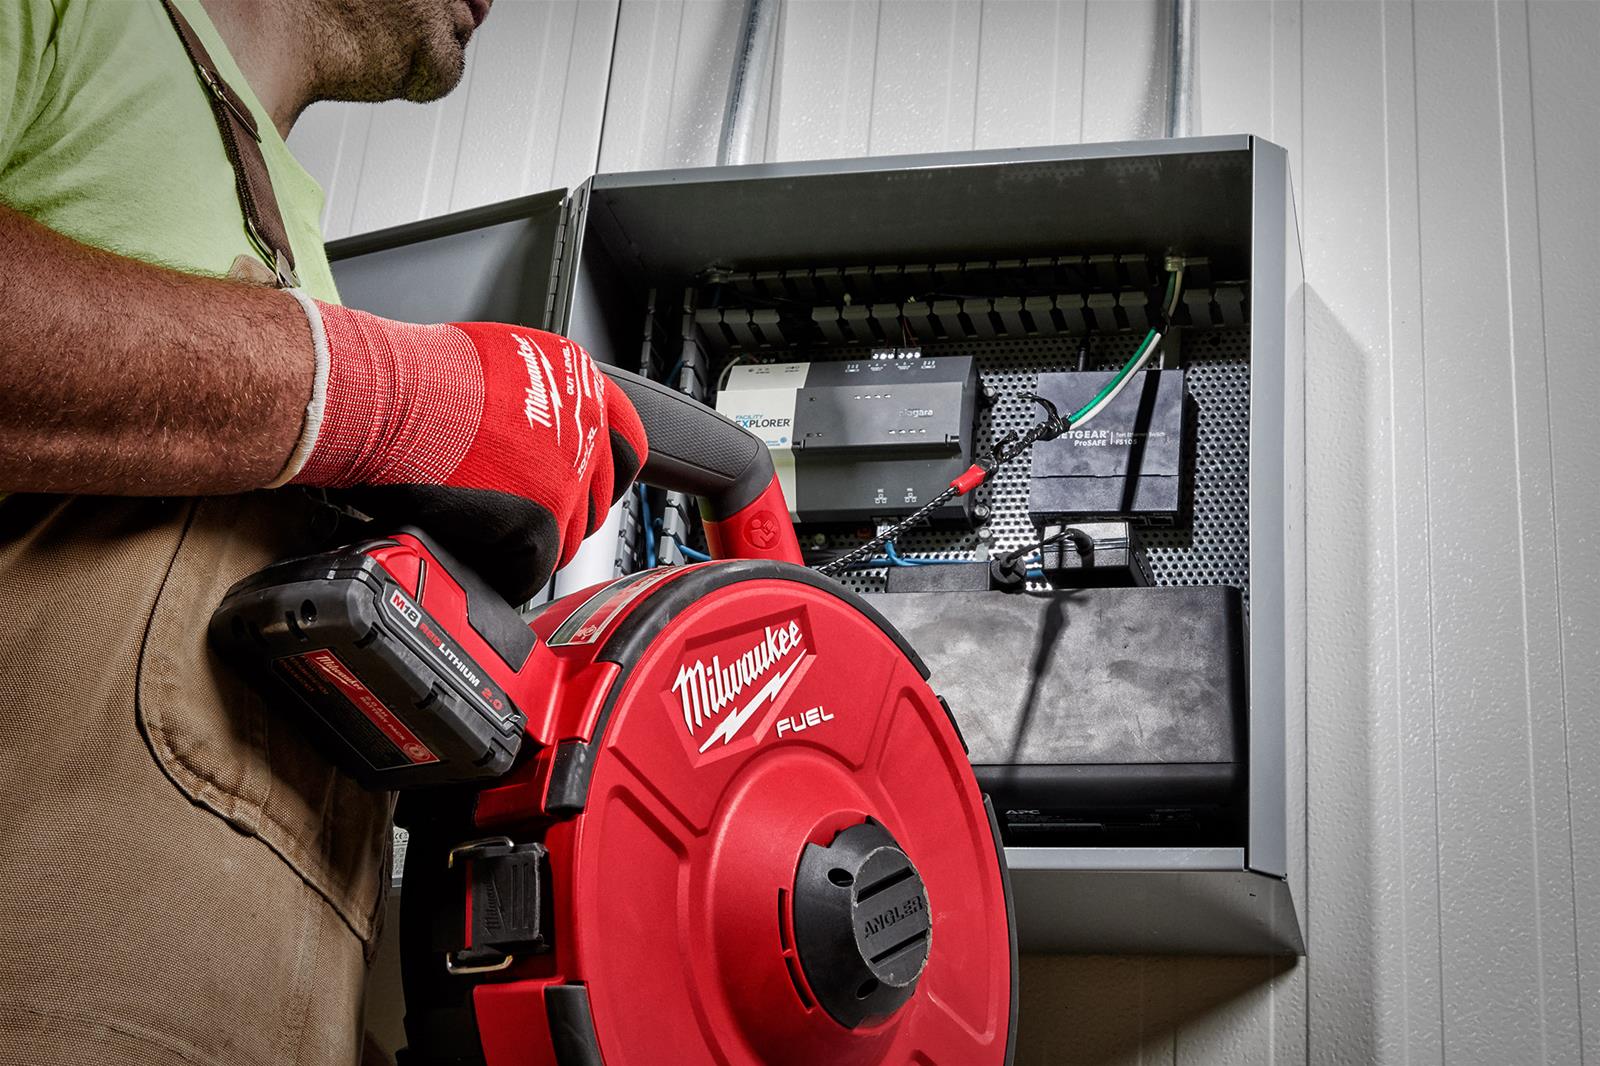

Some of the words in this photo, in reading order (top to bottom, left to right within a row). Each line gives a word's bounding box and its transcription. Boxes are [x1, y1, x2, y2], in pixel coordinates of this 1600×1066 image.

[510, 332, 553, 429] Milwaukee
[562, 346, 574, 374] LEVEL
[566, 375, 575, 396] CUT
[392, 594, 420, 623] M18
[481, 687, 504, 711] 2.0
[672, 620, 803, 737] Milwaukee
[776, 705, 835, 739] FUEL
[864, 895, 924, 939] ANGLER
